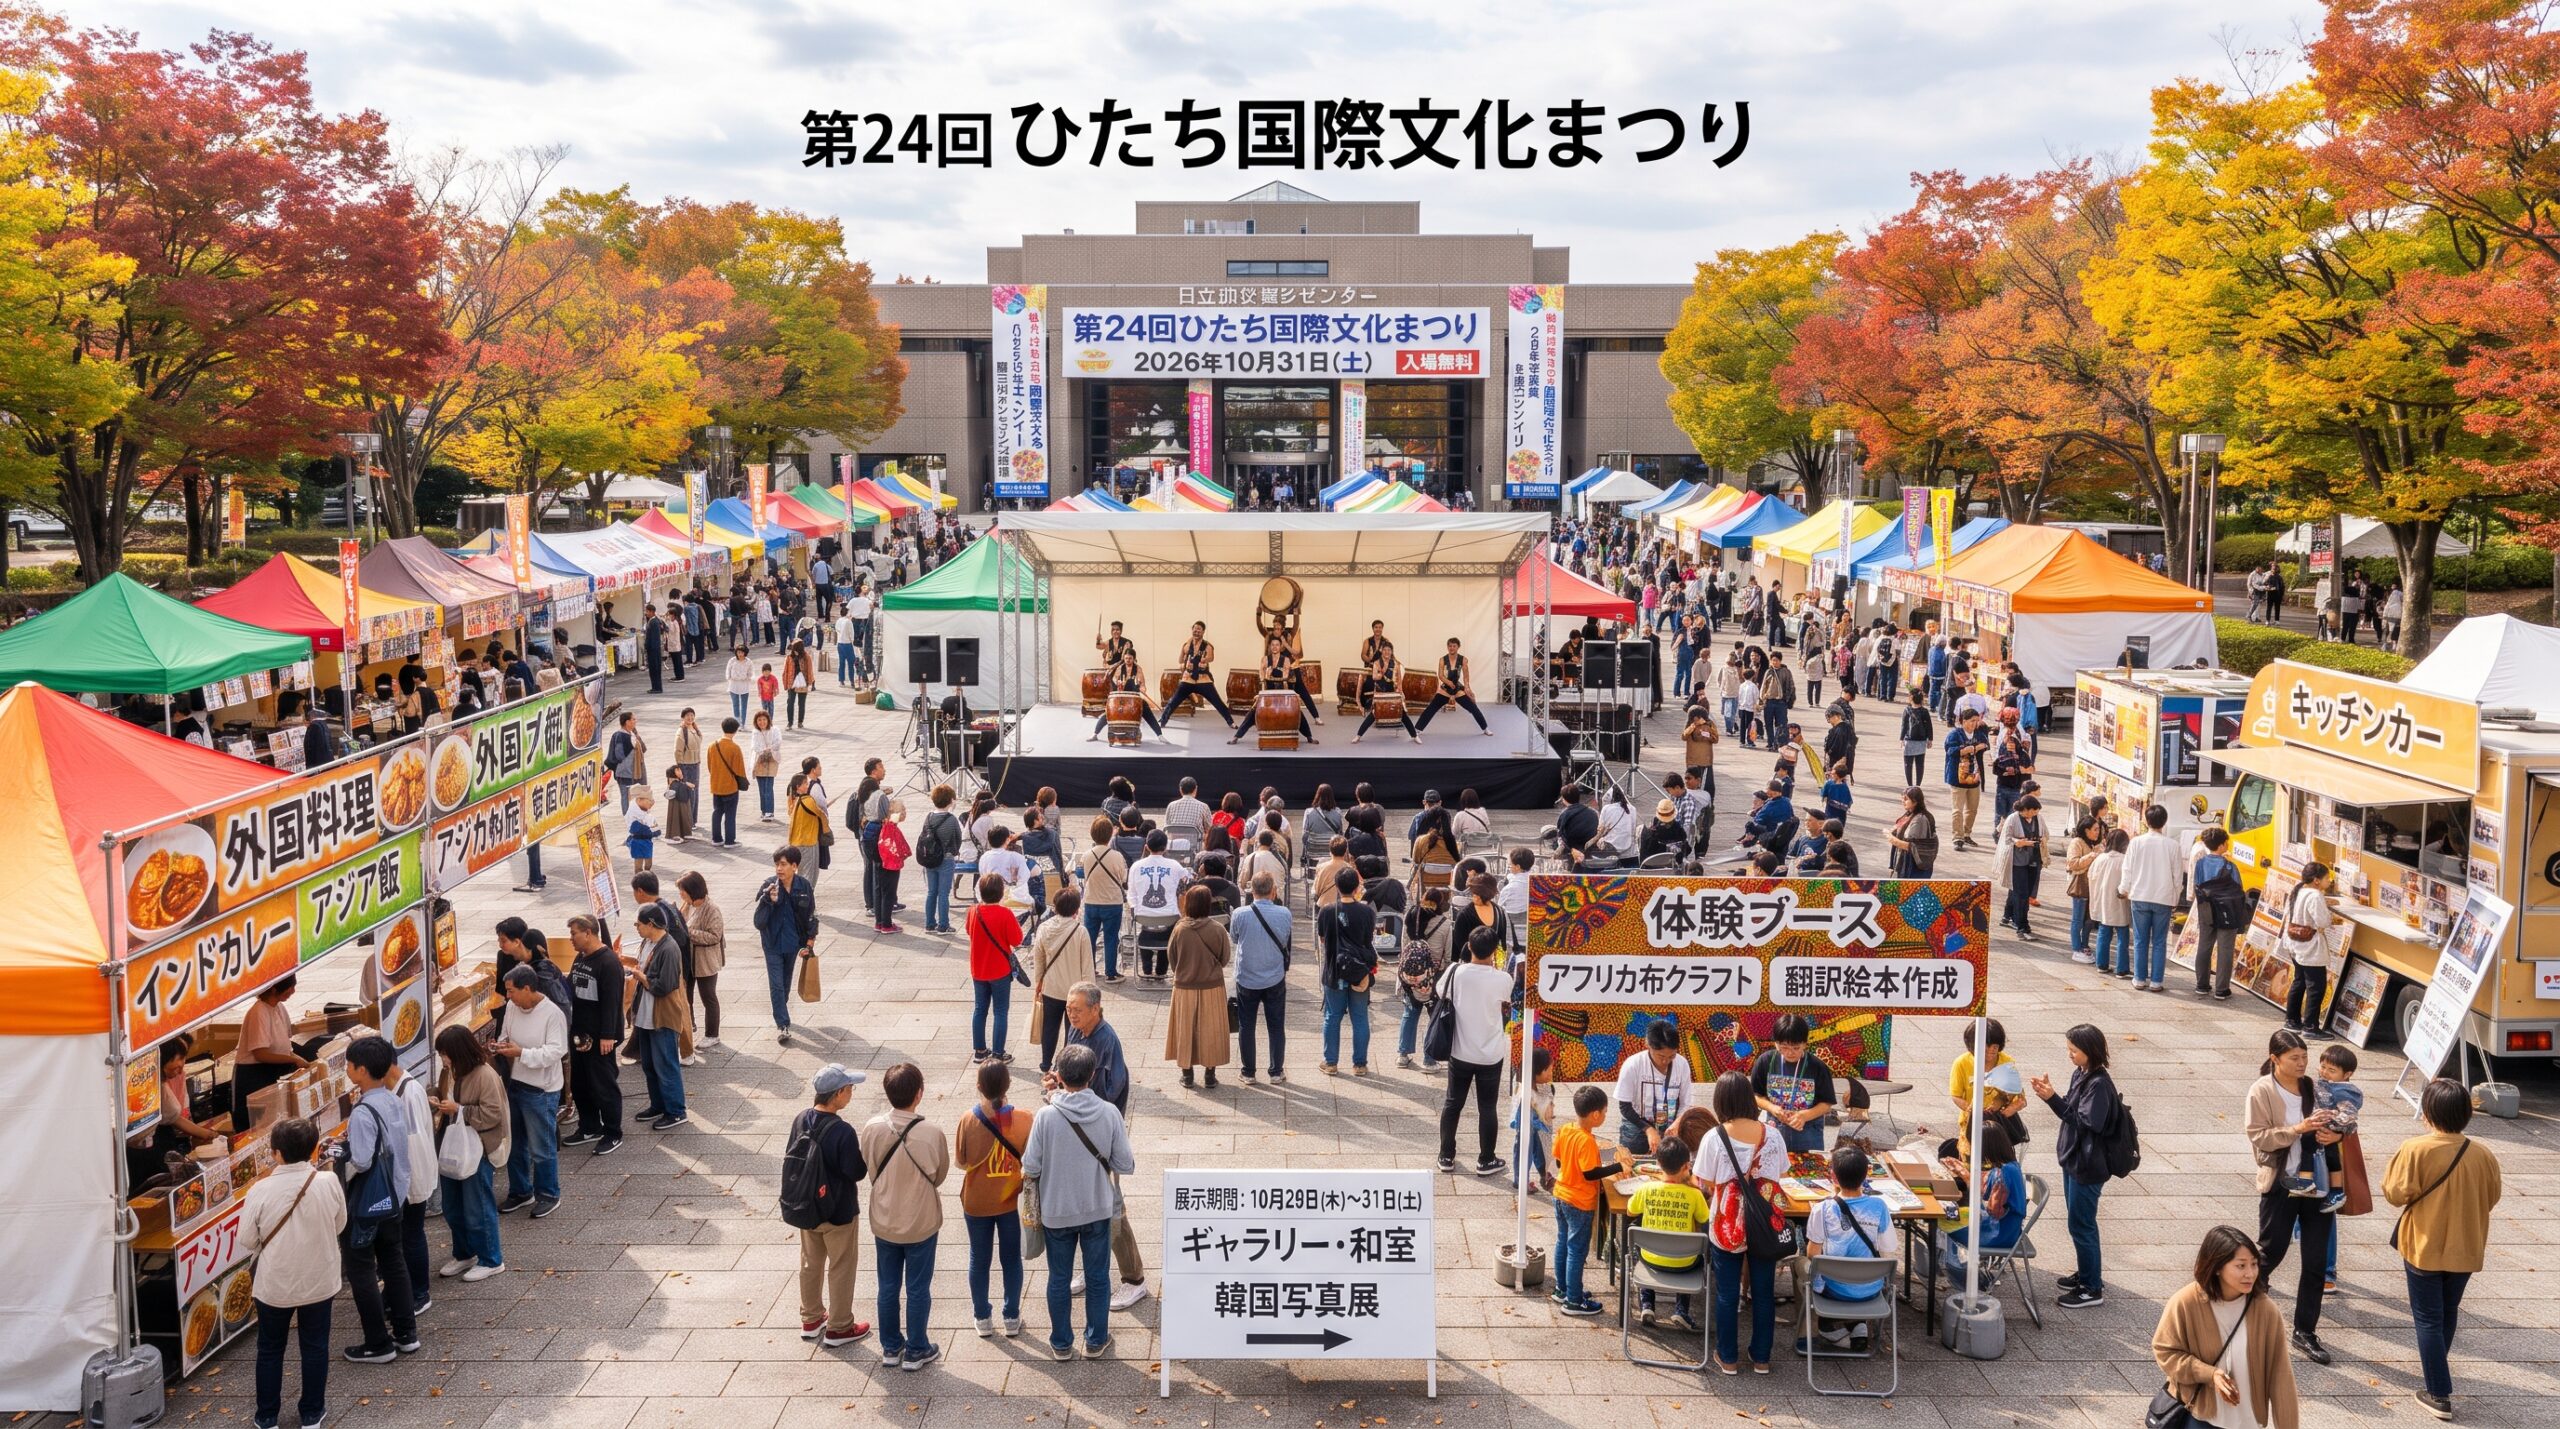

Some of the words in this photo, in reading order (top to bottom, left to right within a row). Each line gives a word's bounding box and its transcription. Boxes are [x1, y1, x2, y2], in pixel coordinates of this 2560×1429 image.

[1074, 313, 1477, 344] 第24回ひたち国際文化まつり
[1134, 351, 1372, 374] 2026年10月31日(土)
[1401, 352, 1473, 371] 入場無料
[2292, 684, 2441, 754] キッチンカー
[225, 773, 376, 888] 外国料理
[311, 850, 401, 935] アジア飯
[1650, 894, 1878, 941] 体験ブース
[137, 921, 291, 1017] インドカレー
[1548, 964, 1752, 996] アフリカ布クラフト
[1785, 965, 1959, 1000] 翻訳絵本作成
[1181, 1226, 1416, 1264] ギャラリー・和室
[1214, 1281, 1380, 1318] 韓国写真展
